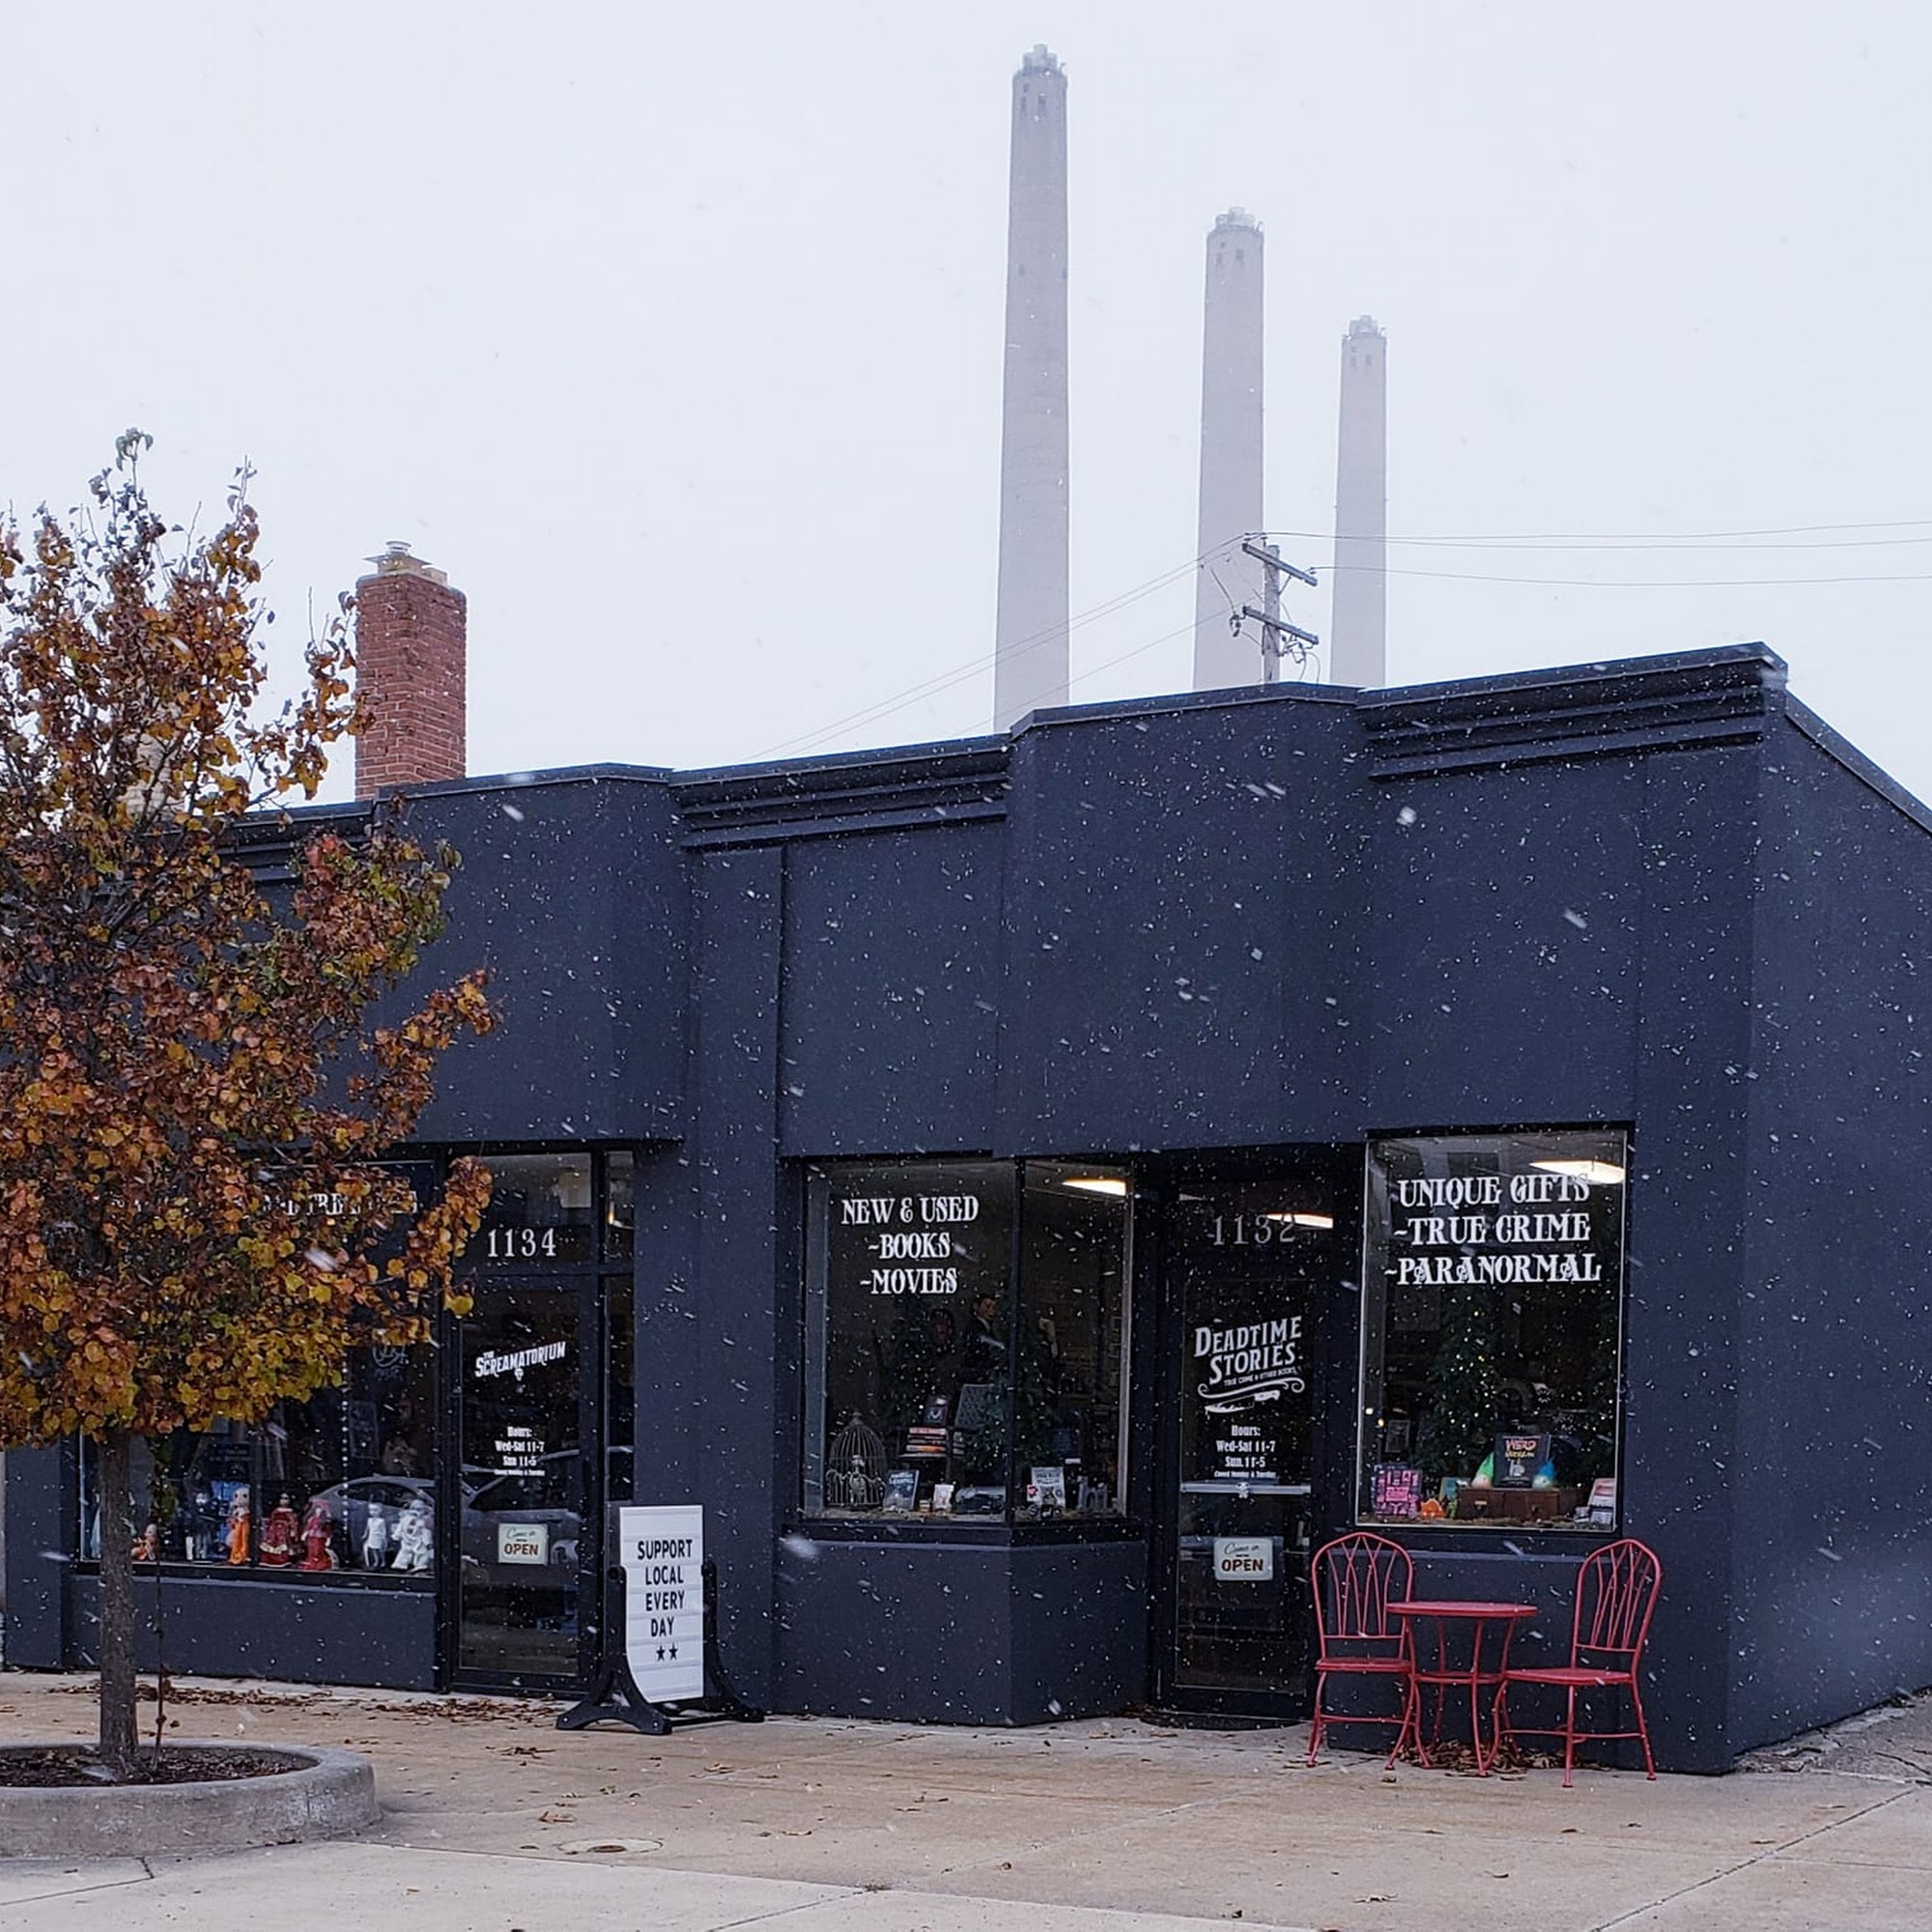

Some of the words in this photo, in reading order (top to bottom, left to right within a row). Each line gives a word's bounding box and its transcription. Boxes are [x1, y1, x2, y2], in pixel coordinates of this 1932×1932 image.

[1397, 1176, 1503, 1208] UNIQUE
[1510, 1173, 1590, 1203] GIFTS
[840, 1198, 895, 1225] NEW
[899, 1197, 914, 1223] &
[919, 1196, 980, 1222] USED
[1212, 1213, 1296, 1245] 1132
[1496, 1212, 1591, 1243] CRIME
[488, 1228, 556, 1257] 1134
[1194, 1315, 1302, 1357] DEADTIME
[474, 1341, 566, 1378] SCREAMATORIUM
[1208, 1342, 1295, 1385] STORIES
[1232, 1424, 1261, 1436] Hours:
[527, 1441, 545, 1452] 11-7
[1216, 1440, 1252, 1452] Wed-Sat
[1256, 1440, 1276, 1452] 11-7
[1245, 1456, 1265, 1468] 11-5
[504, 1543, 538, 1555] OPEN
[638, 1539, 693, 1560] SUPPORT
[645, 1565, 684, 1585] LOCAL
[1221, 1558, 1264, 1572] OPEN
[645, 1589, 685, 1611] EVERY
[651, 1616, 674, 1637] DAY
